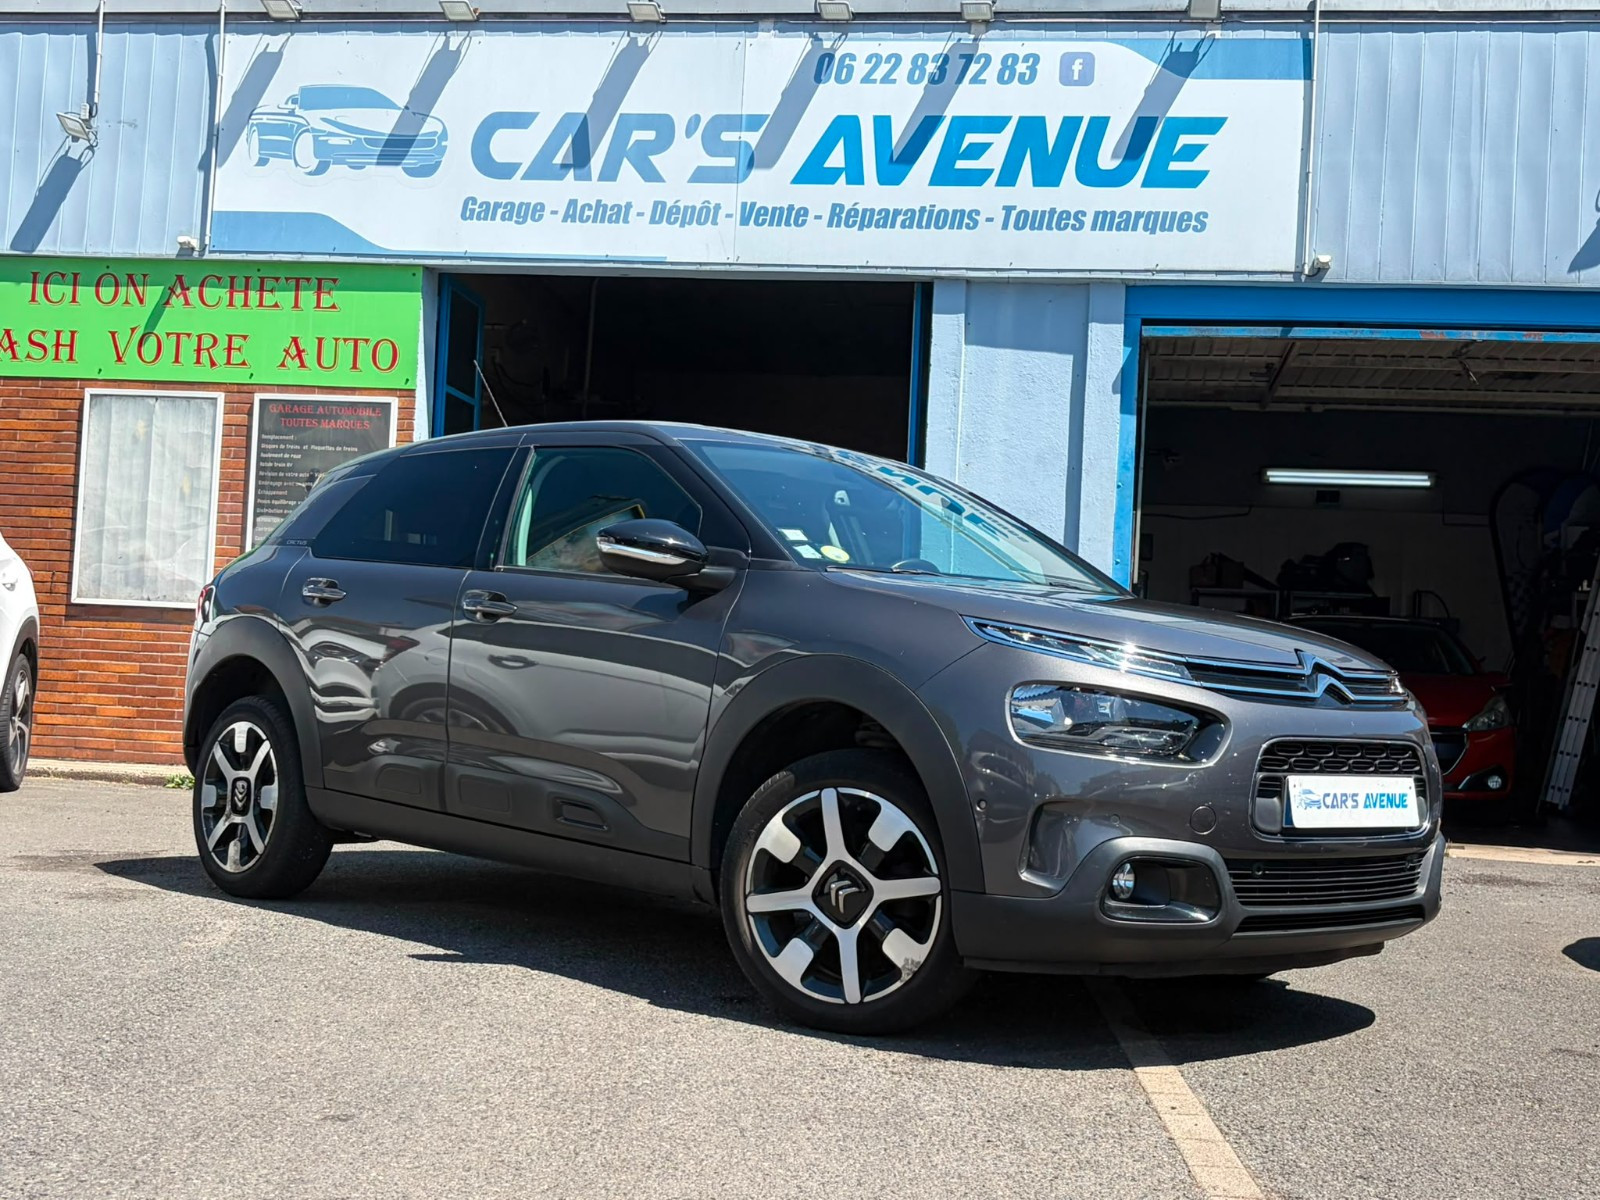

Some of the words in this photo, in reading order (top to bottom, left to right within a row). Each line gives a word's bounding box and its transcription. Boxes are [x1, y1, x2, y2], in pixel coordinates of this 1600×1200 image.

[813, 52, 855, 85] 06
[860, 53, 901, 85] 22
[907, 53, 951, 85] 83
[955, 53, 992, 85] 72
[996, 53, 1041, 86] 83
[471, 111, 770, 184] CAR'S
[790, 114, 1229, 189] AVENUE
[460, 196, 545, 225] Garage
[561, 198, 633, 225] Achat
[649, 199, 724, 229] Dépôt
[738, 202, 808, 228] Vente
[827, 203, 981, 232] Réparations
[1000, 205, 1087, 232] Toutes
[1089, 209, 1209, 236] marques
[28, 271, 81, 306] ICI
[94, 272, 151, 307] ON
[162, 274, 341, 312] ACHETE
[108, 325, 252, 370] VOTRE
[276, 336, 400, 373] AUTO
[268, 404, 314, 414] GARAGE
[316, 405, 382, 417] AUTOMOBILE
[280, 418, 319, 428] TOUTES
[320, 419, 371, 430] MARQUES
[1322, 792, 1358, 809] CAR'S
[1363, 792, 1408, 809] AVENUE
